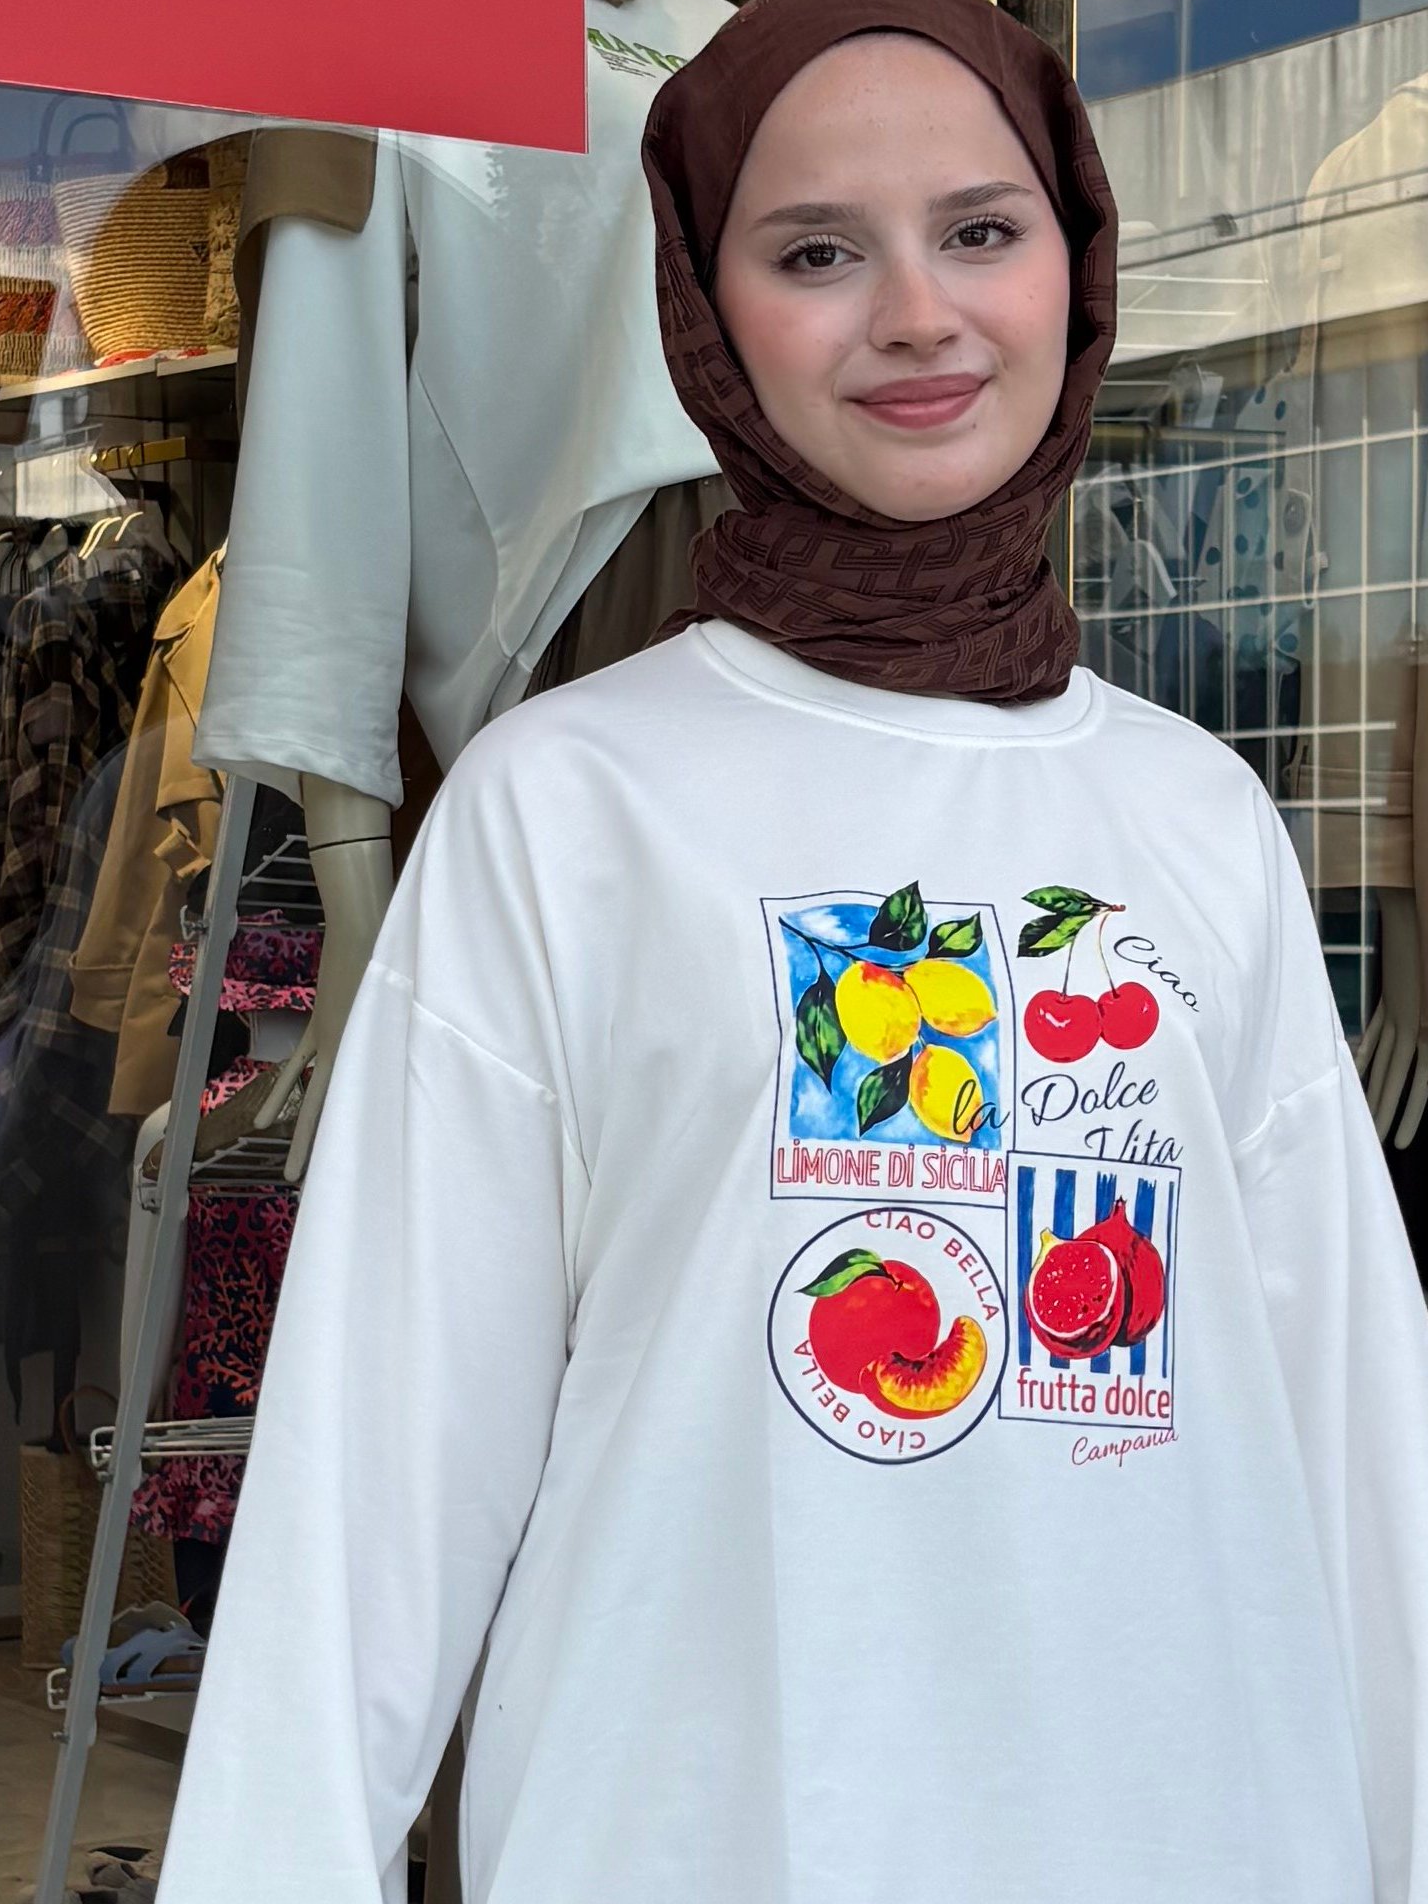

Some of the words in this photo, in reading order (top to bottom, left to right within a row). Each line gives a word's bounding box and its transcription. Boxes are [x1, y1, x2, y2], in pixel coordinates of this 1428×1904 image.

[1113, 935, 1200, 1013] Ciao
[952, 1078, 1011, 1135] la
[1021, 1061, 1160, 1127] Dolce
[1084, 1118, 1184, 1165] Vita
[942, 1237, 1000, 1322] BELLA
[793, 1339, 851, 1423] BELLA
[1016, 1367, 1097, 1414] frutta
[1104, 1373, 1171, 1420] dolce
